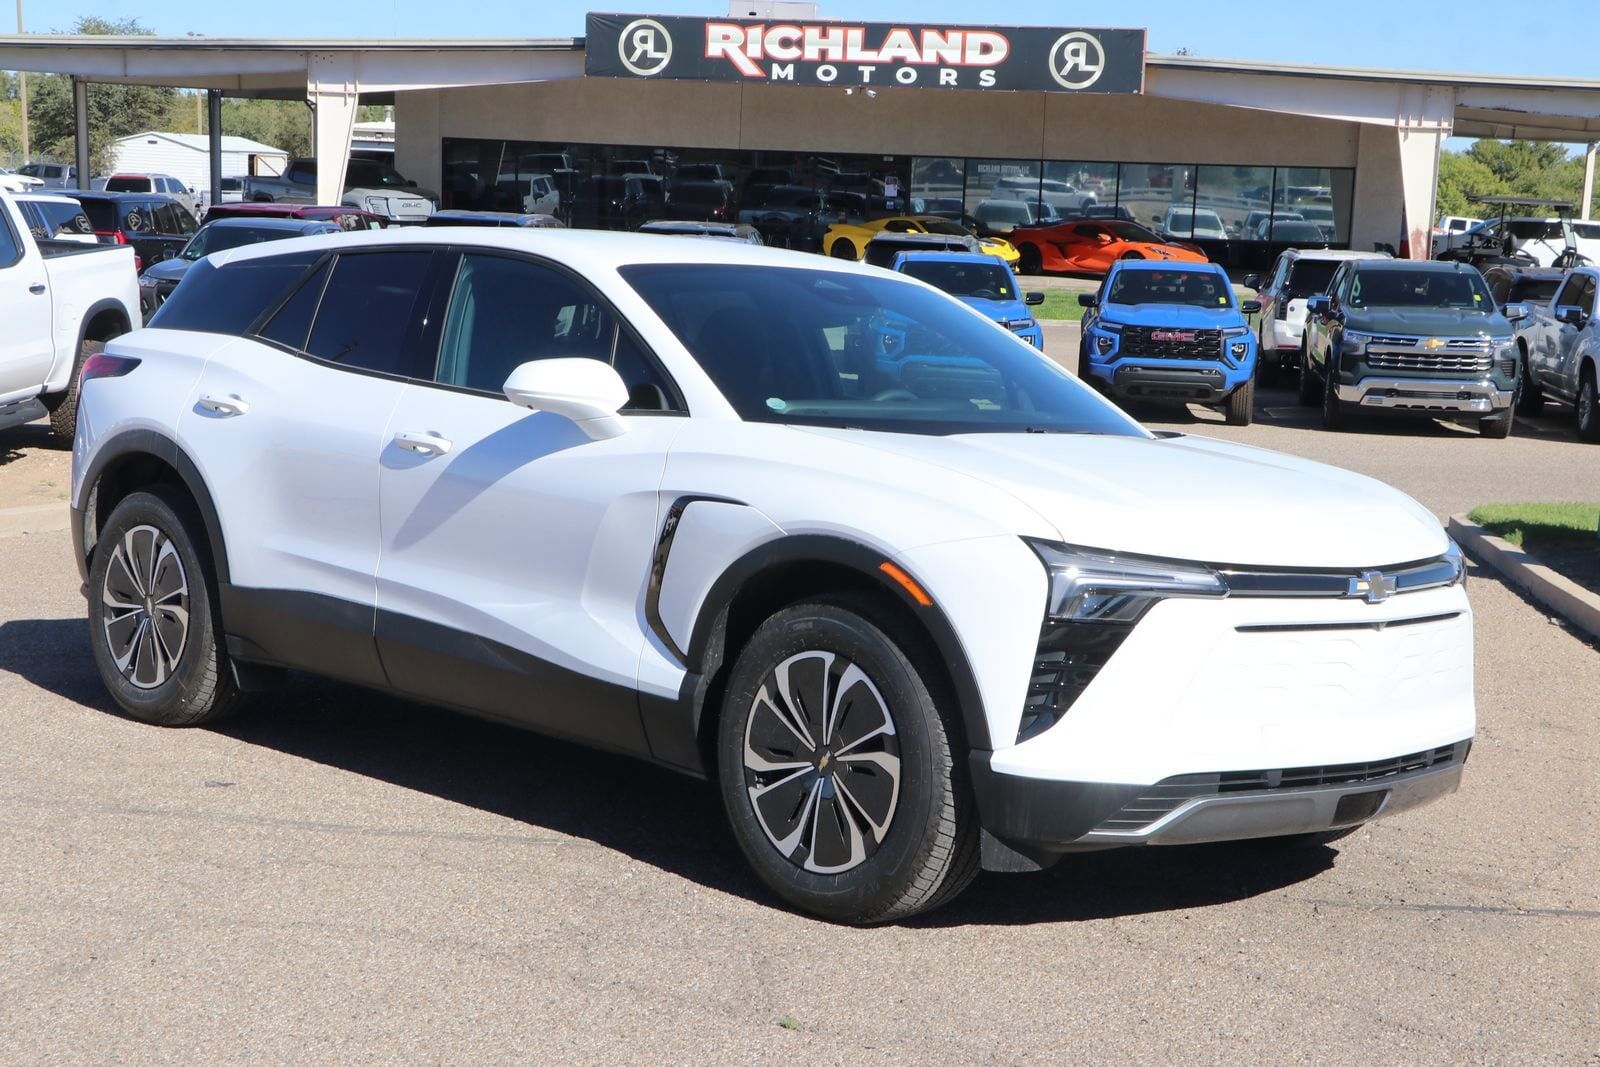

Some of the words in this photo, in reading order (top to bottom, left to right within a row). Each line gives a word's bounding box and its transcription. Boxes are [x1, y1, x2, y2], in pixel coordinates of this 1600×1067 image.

[705, 22, 1010, 77] RICHLAND
[771, 63, 997, 87] MOTORS
[1151, 331, 1196, 342] GMC
